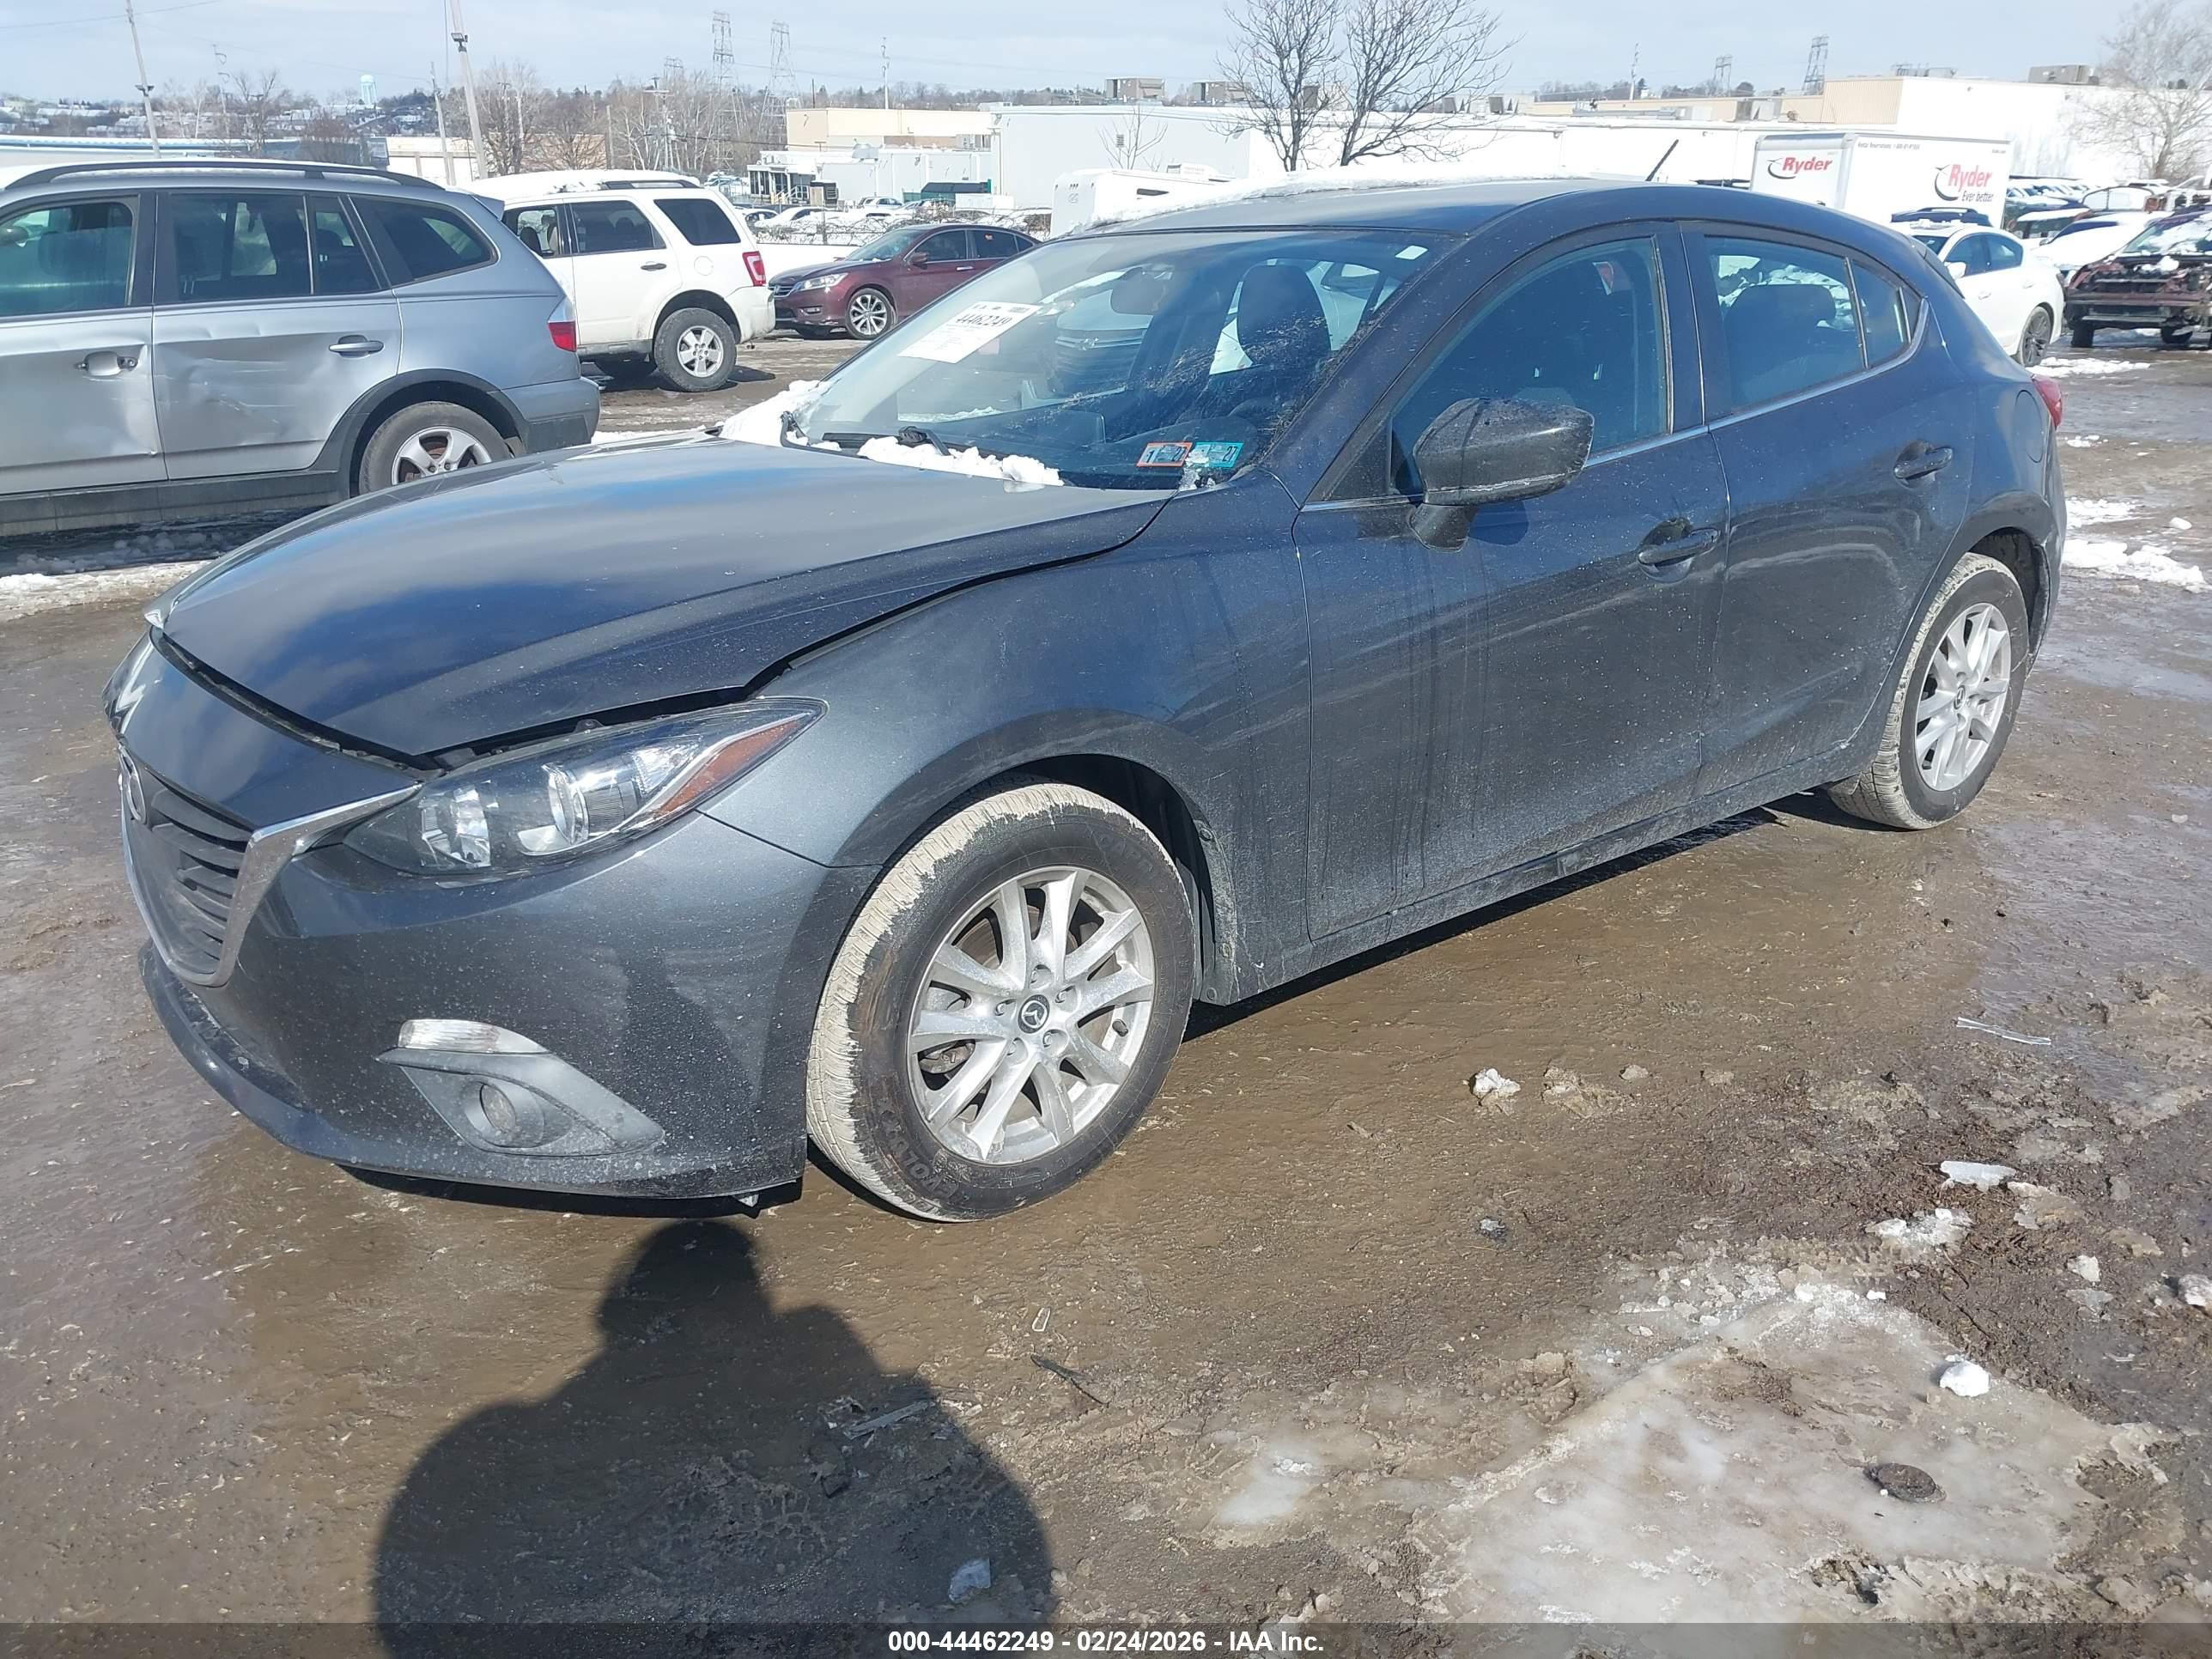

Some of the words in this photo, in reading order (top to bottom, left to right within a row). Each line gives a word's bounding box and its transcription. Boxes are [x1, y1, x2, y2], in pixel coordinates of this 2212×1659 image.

[1782, 156, 1833, 174] Ryder
[1947, 164, 1993, 192] Ryder
[1961, 190, 1976, 203] Ever
[1976, 191, 1995, 203] better
